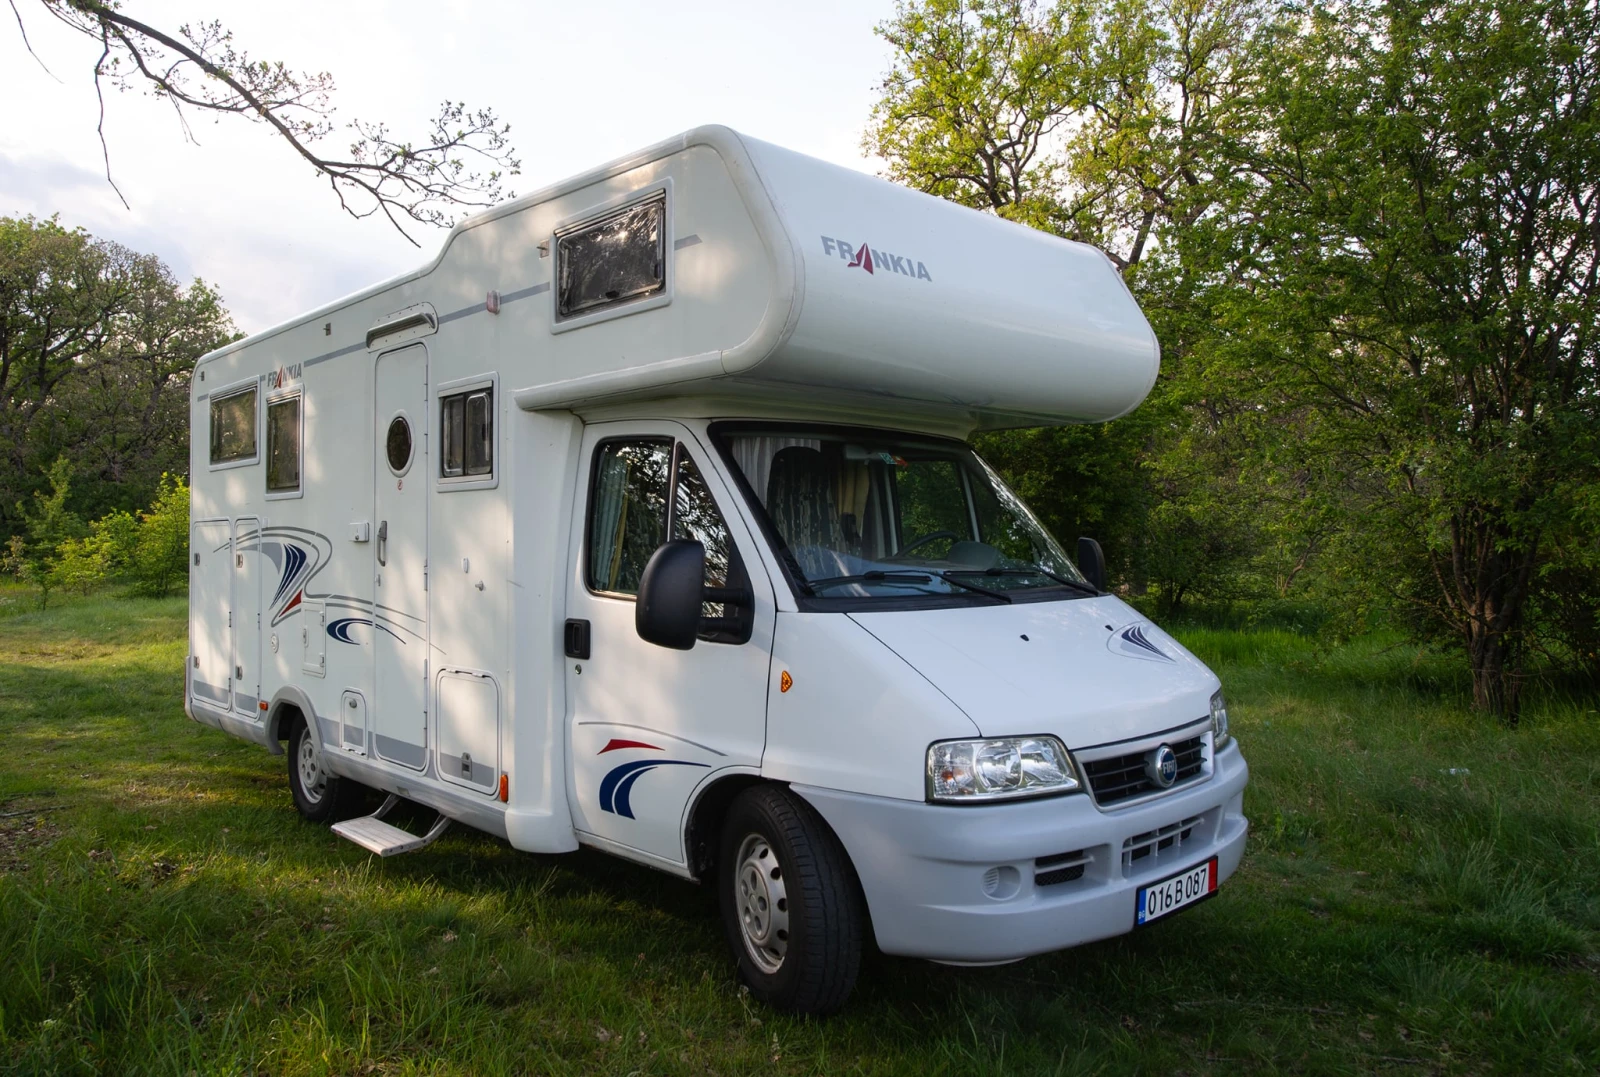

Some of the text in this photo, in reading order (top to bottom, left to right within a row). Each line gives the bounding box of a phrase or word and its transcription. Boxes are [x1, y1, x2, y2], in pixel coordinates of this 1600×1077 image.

[820, 235, 932, 282] FRANKIA
[267, 363, 302, 389] FRANKIA
[1162, 760, 1175, 774] FIAT
